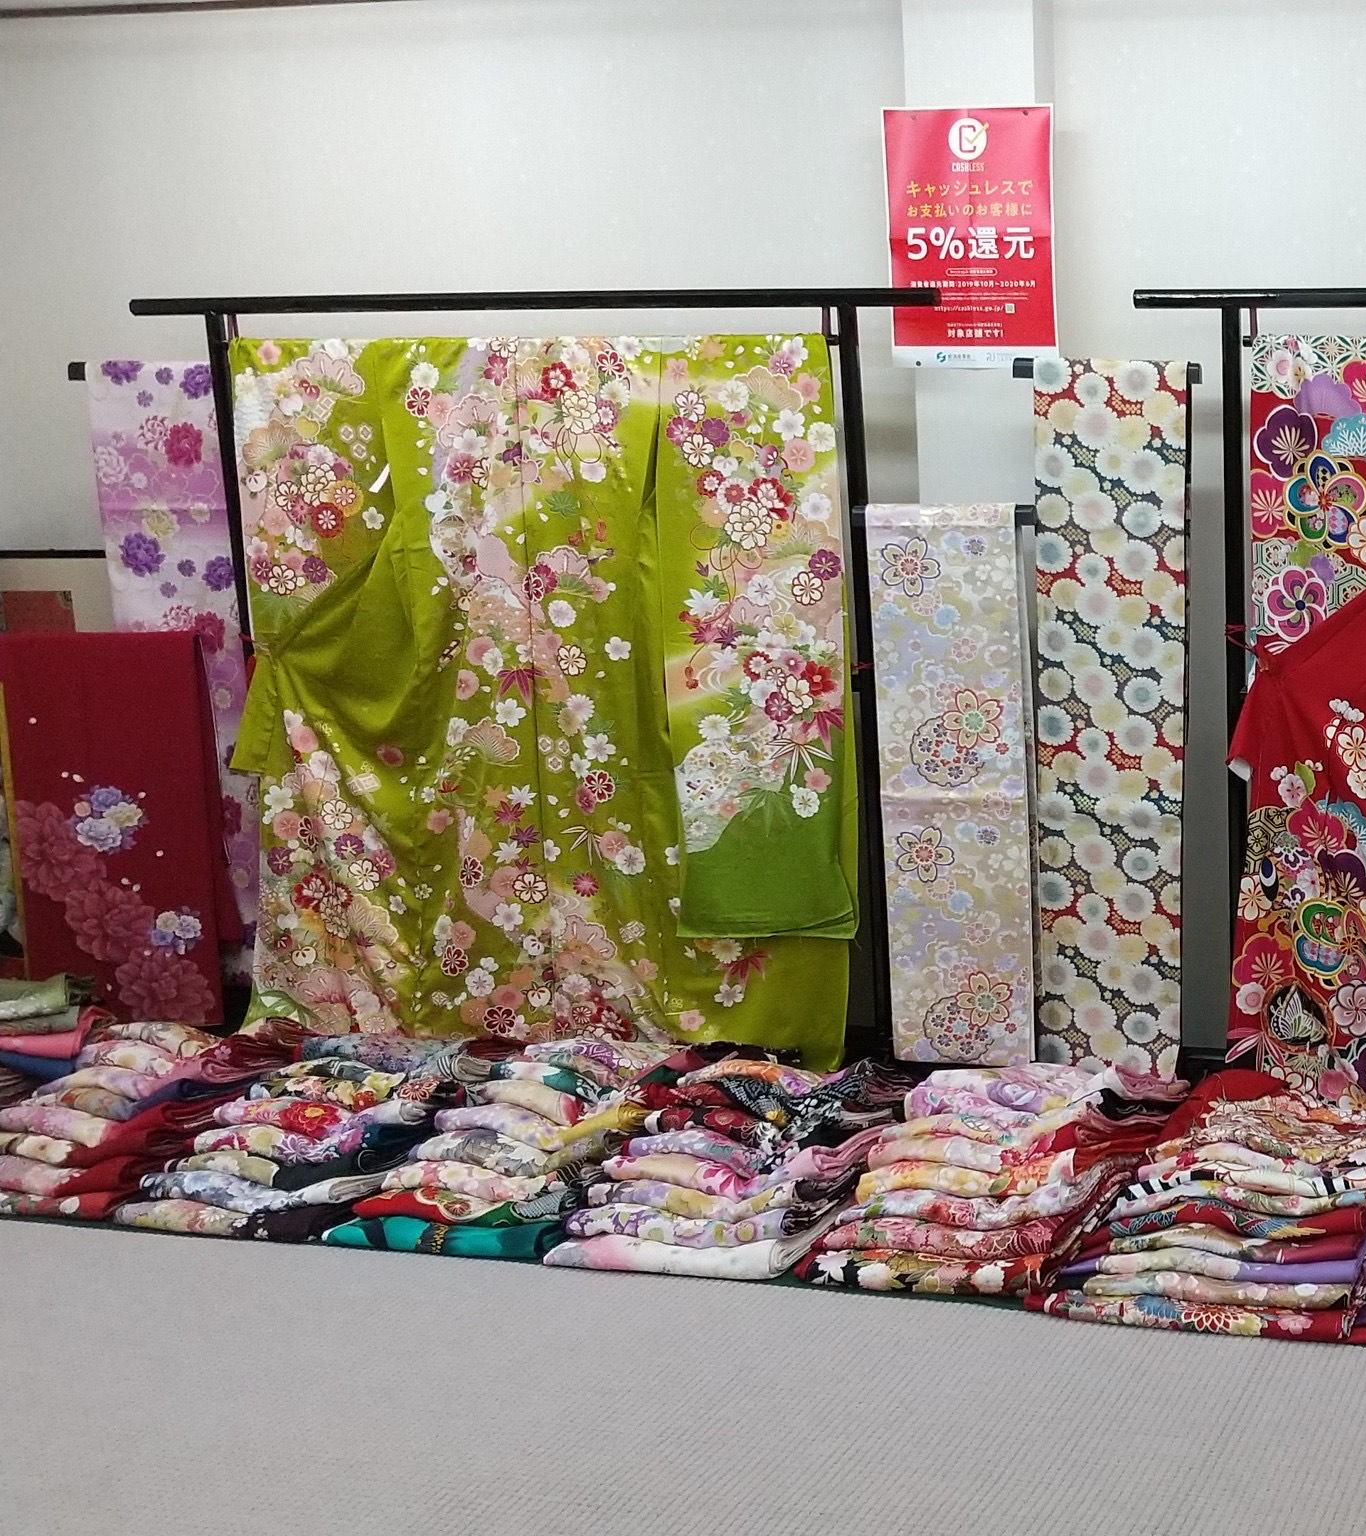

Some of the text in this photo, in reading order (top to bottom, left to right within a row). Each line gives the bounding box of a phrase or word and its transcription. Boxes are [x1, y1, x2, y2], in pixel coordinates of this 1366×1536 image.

[951, 162, 985, 172] CASHLESS
[906, 180, 1033, 198] キャッシュレスで
[906, 203, 1033, 218] お支払いのお客様に
[907, 226, 1035, 260] 5%還元
